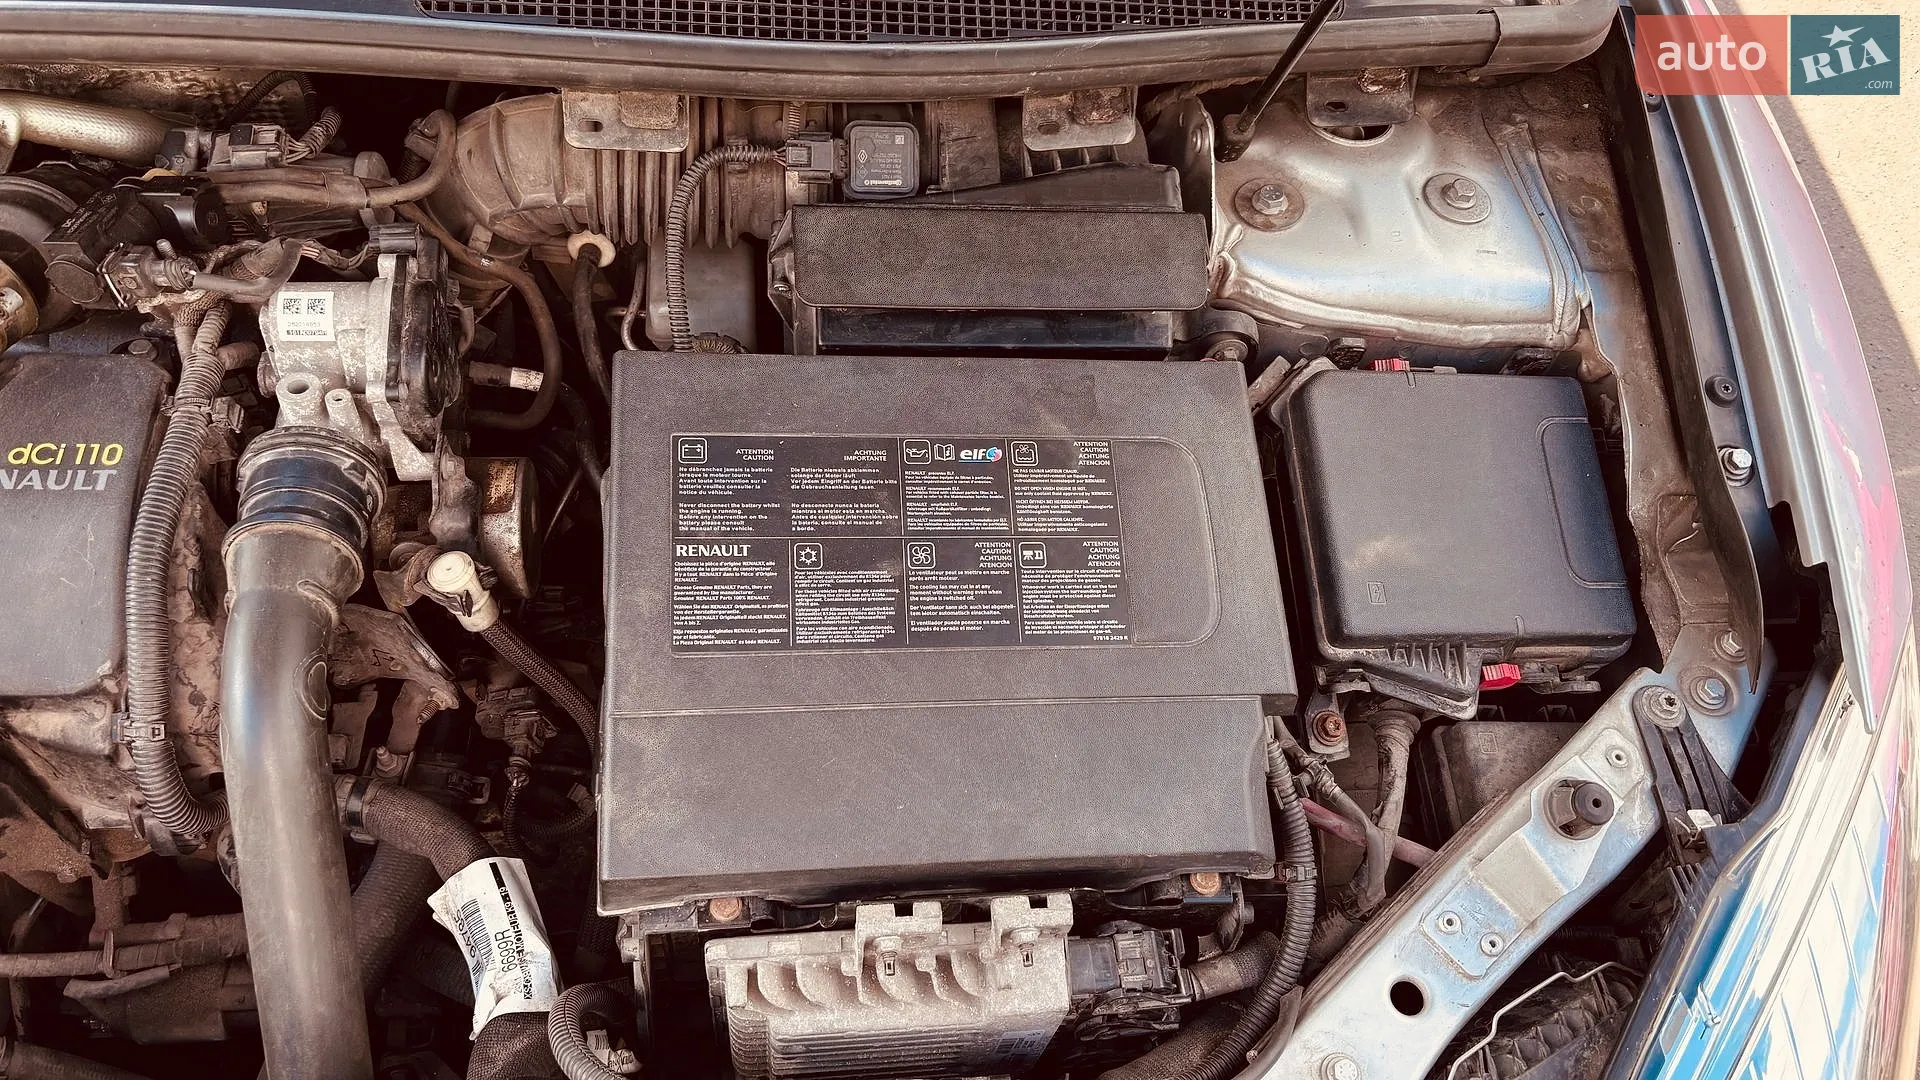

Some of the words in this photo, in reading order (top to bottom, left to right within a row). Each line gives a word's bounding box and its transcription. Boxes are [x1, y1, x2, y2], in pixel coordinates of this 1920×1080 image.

[8, 443, 66, 465] dCi
[76, 443, 124, 466] 110
[960, 449, 986, 459] elf
[0, 469, 117, 490] NAULT
[676, 545, 751, 556] RENAULT
